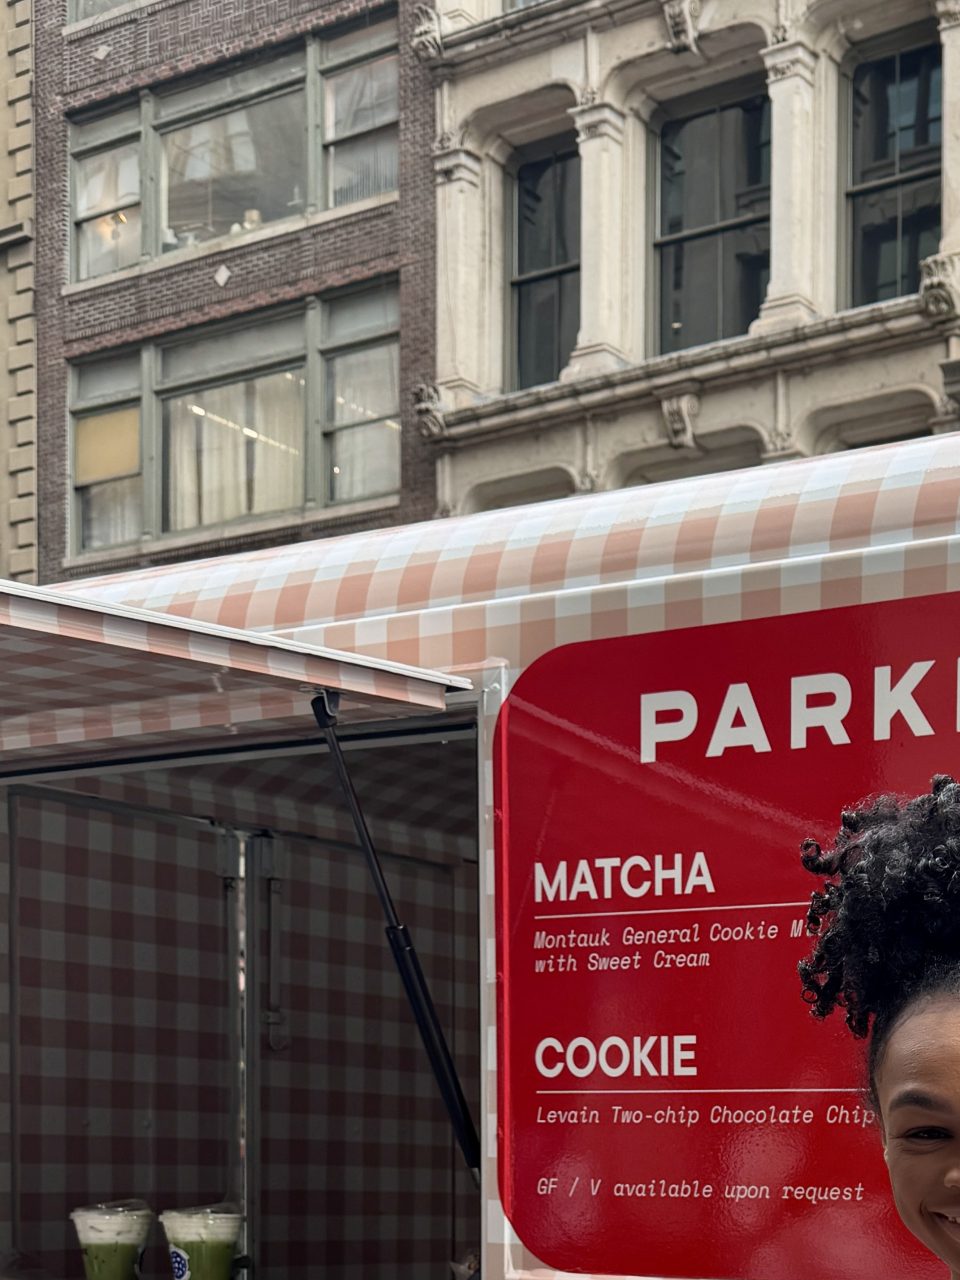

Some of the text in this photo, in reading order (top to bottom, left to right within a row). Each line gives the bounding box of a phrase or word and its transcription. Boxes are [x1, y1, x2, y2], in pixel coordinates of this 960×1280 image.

[534, 851, 716, 903] MATCHA
[534, 928, 610, 949] Montauk
[622, 923, 701, 945] General
[709, 922, 779, 942] Cookie
[535, 950, 711, 973] with Sweet Cream
[535, 1035, 698, 1078] COOKIE
[536, 1106, 600, 1124] Levain
[611, 1105, 700, 1128] Two-chip
[710, 1105, 814, 1124] Chocolate
[537, 1178, 559, 1196] GF
[590, 1179, 602, 1196] V
[614, 1179, 714, 1199] available
[725, 1183, 770, 1203] upon
[783, 1183, 865, 1205] request
